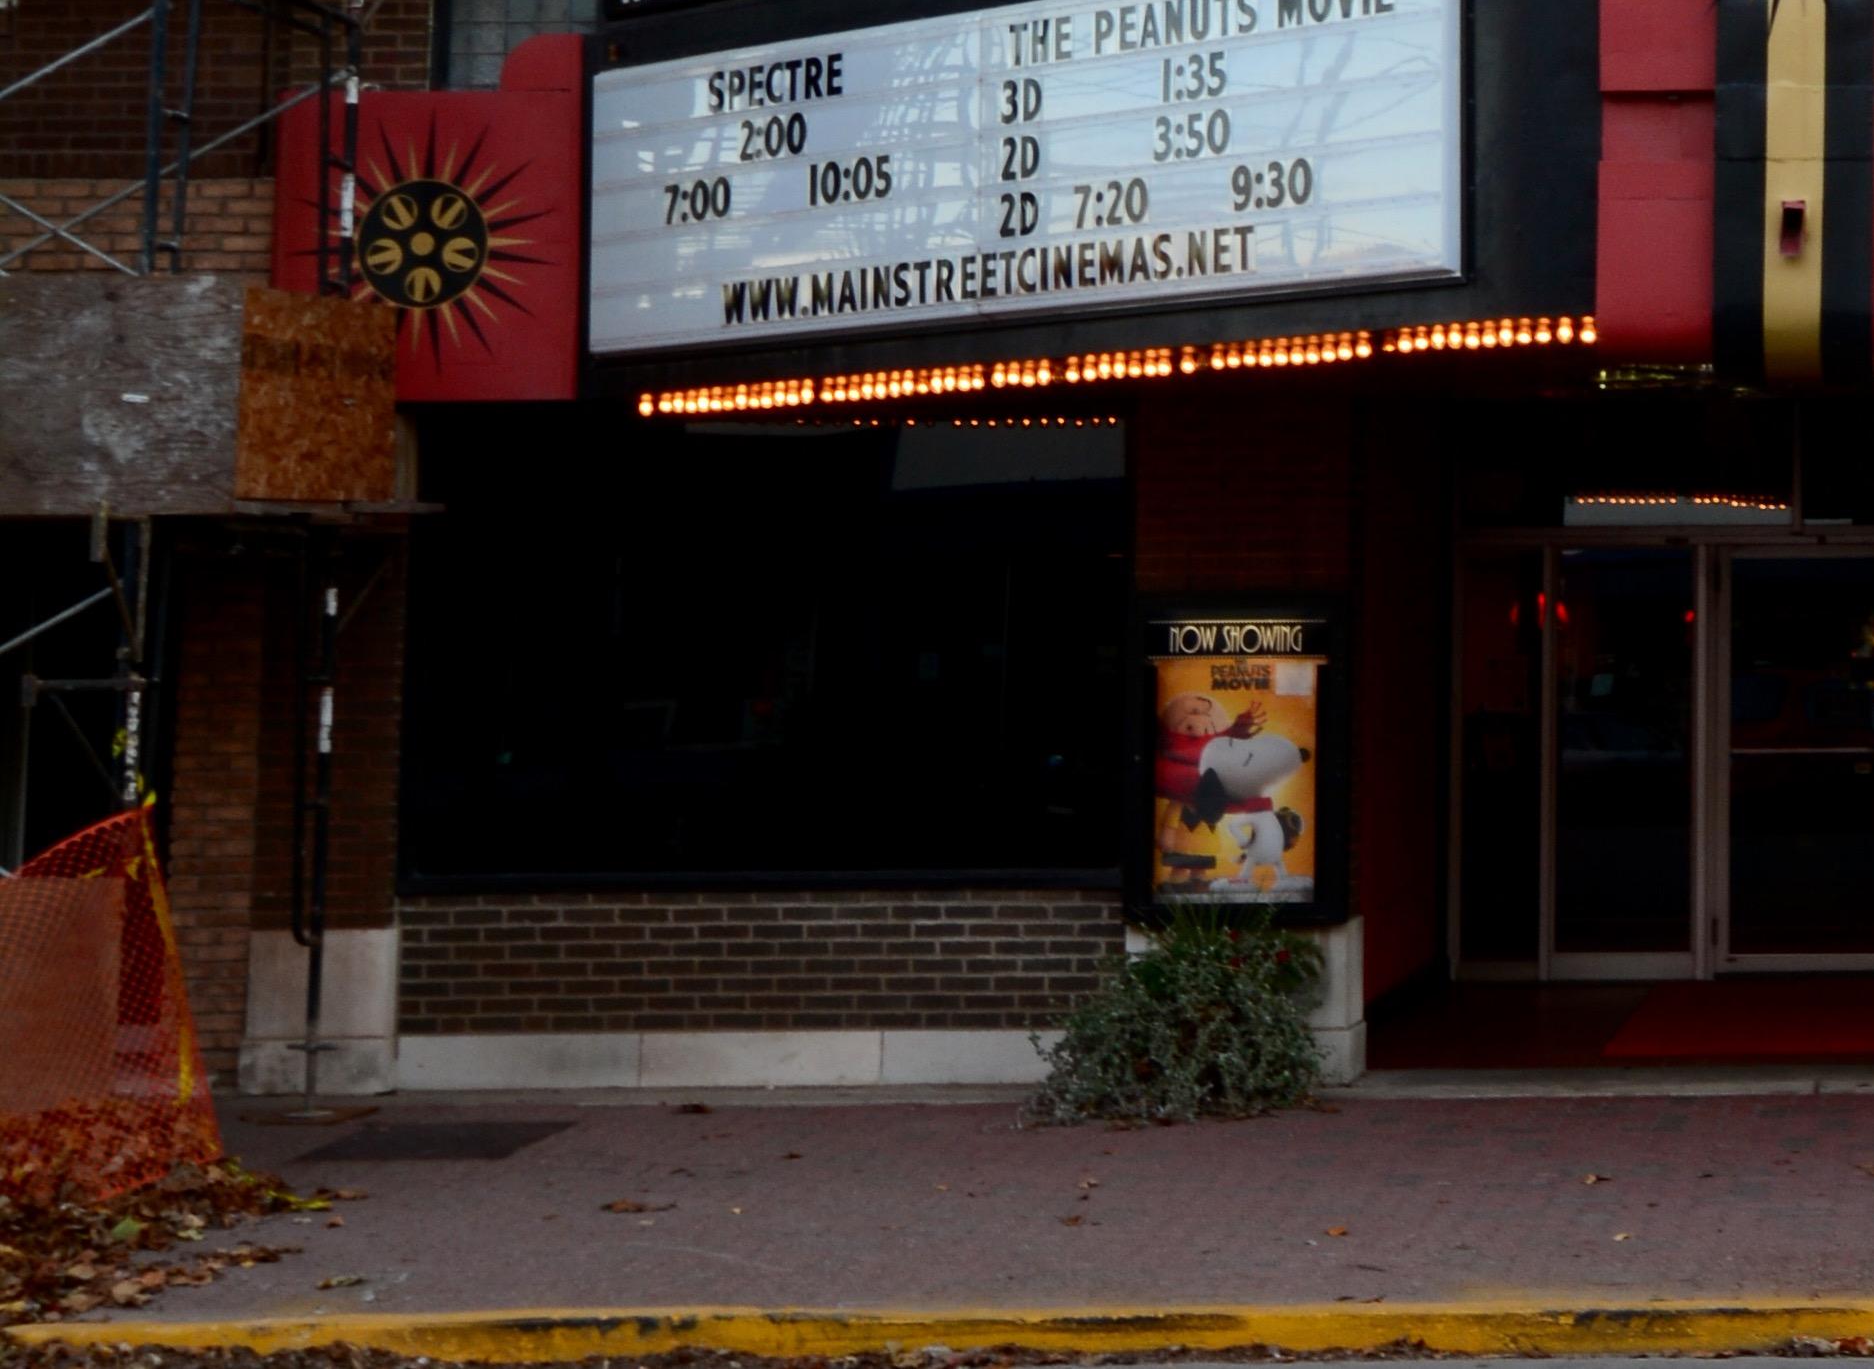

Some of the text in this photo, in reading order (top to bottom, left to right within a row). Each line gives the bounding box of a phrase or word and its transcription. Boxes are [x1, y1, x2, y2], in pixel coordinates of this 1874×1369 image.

[1009, 16, 1072, 66] THE
[708, 53, 843, 112] SPECTRE
[1000, 51, 1227, 124] 3D 1:35
[740, 112, 807, 162] 2:00
[1000, 109, 1231, 181] 2D 3:50
[664, 154, 892, 225] 7:00 10:05
[999, 158, 1314, 238] 2D 7:20 9:30
[722, 226, 1255, 325] WWW.MAINSTREETCINEMAS.NET
[1169, 625, 1302, 654] NOW SHOWING
